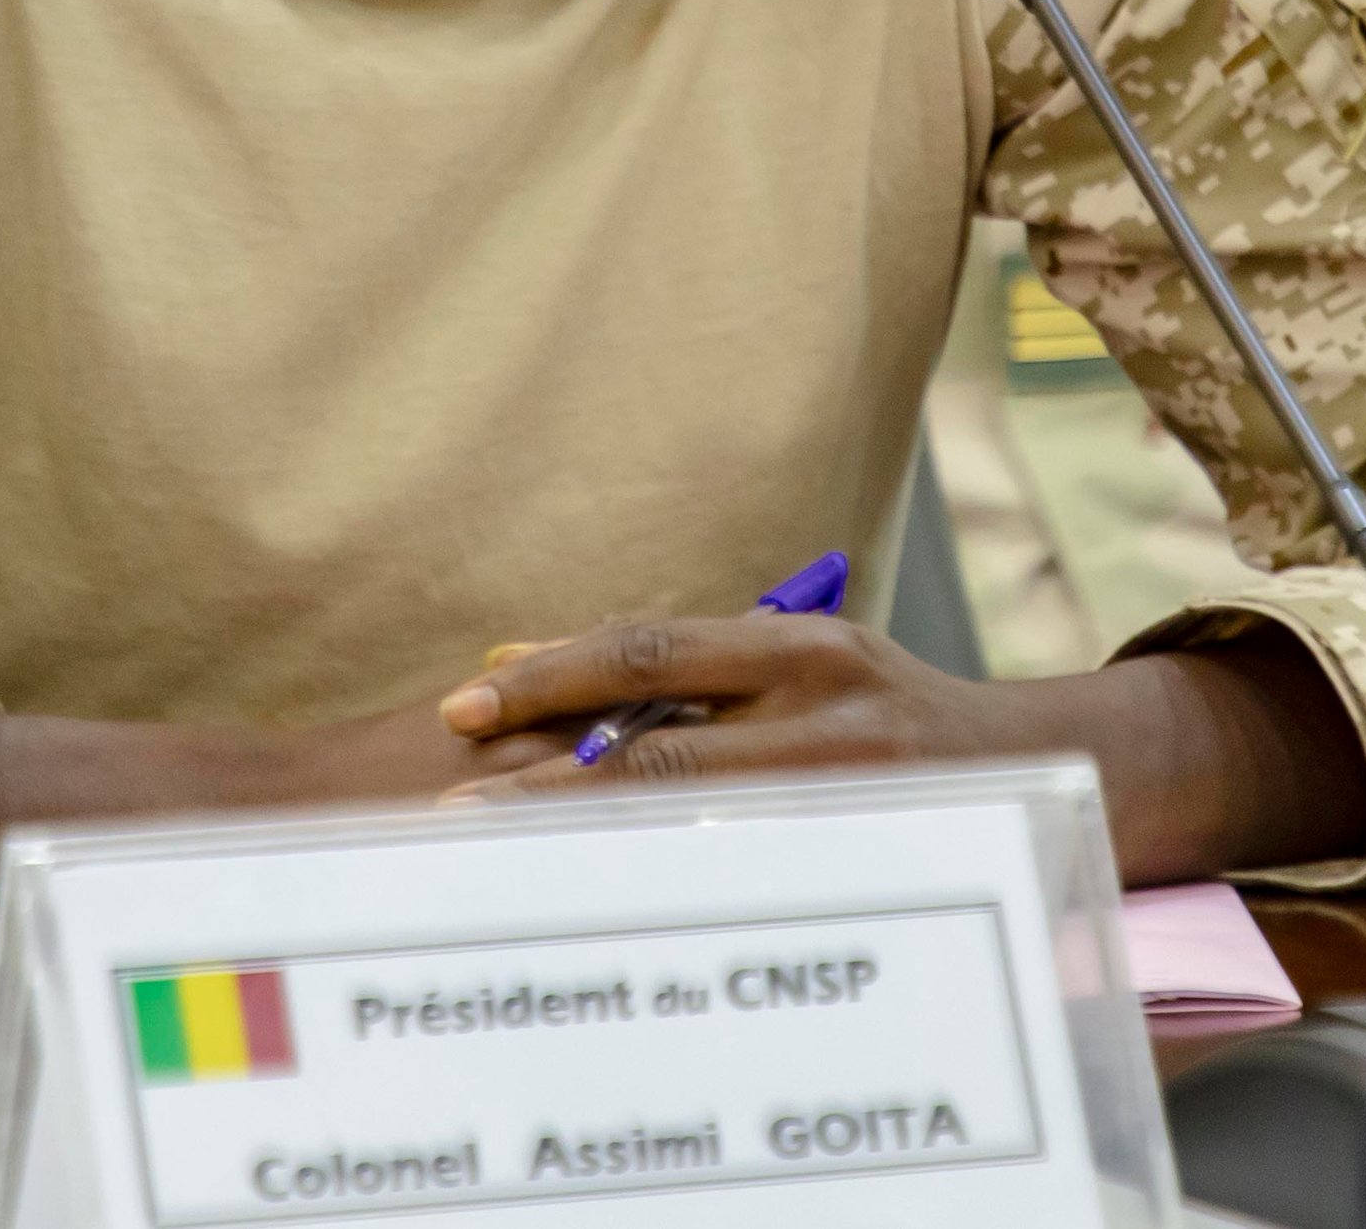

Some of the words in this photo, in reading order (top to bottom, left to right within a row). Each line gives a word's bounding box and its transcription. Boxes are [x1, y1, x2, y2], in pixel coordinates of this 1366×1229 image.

[352, 980, 635, 1040] Président
[652, 983, 710, 1019] du
[726, 958, 879, 1011] CNSP
[251, 1140, 481, 1203] Colonel
[528, 1121, 723, 1181] Assimi
[768, 1103, 971, 1161] GOITA
